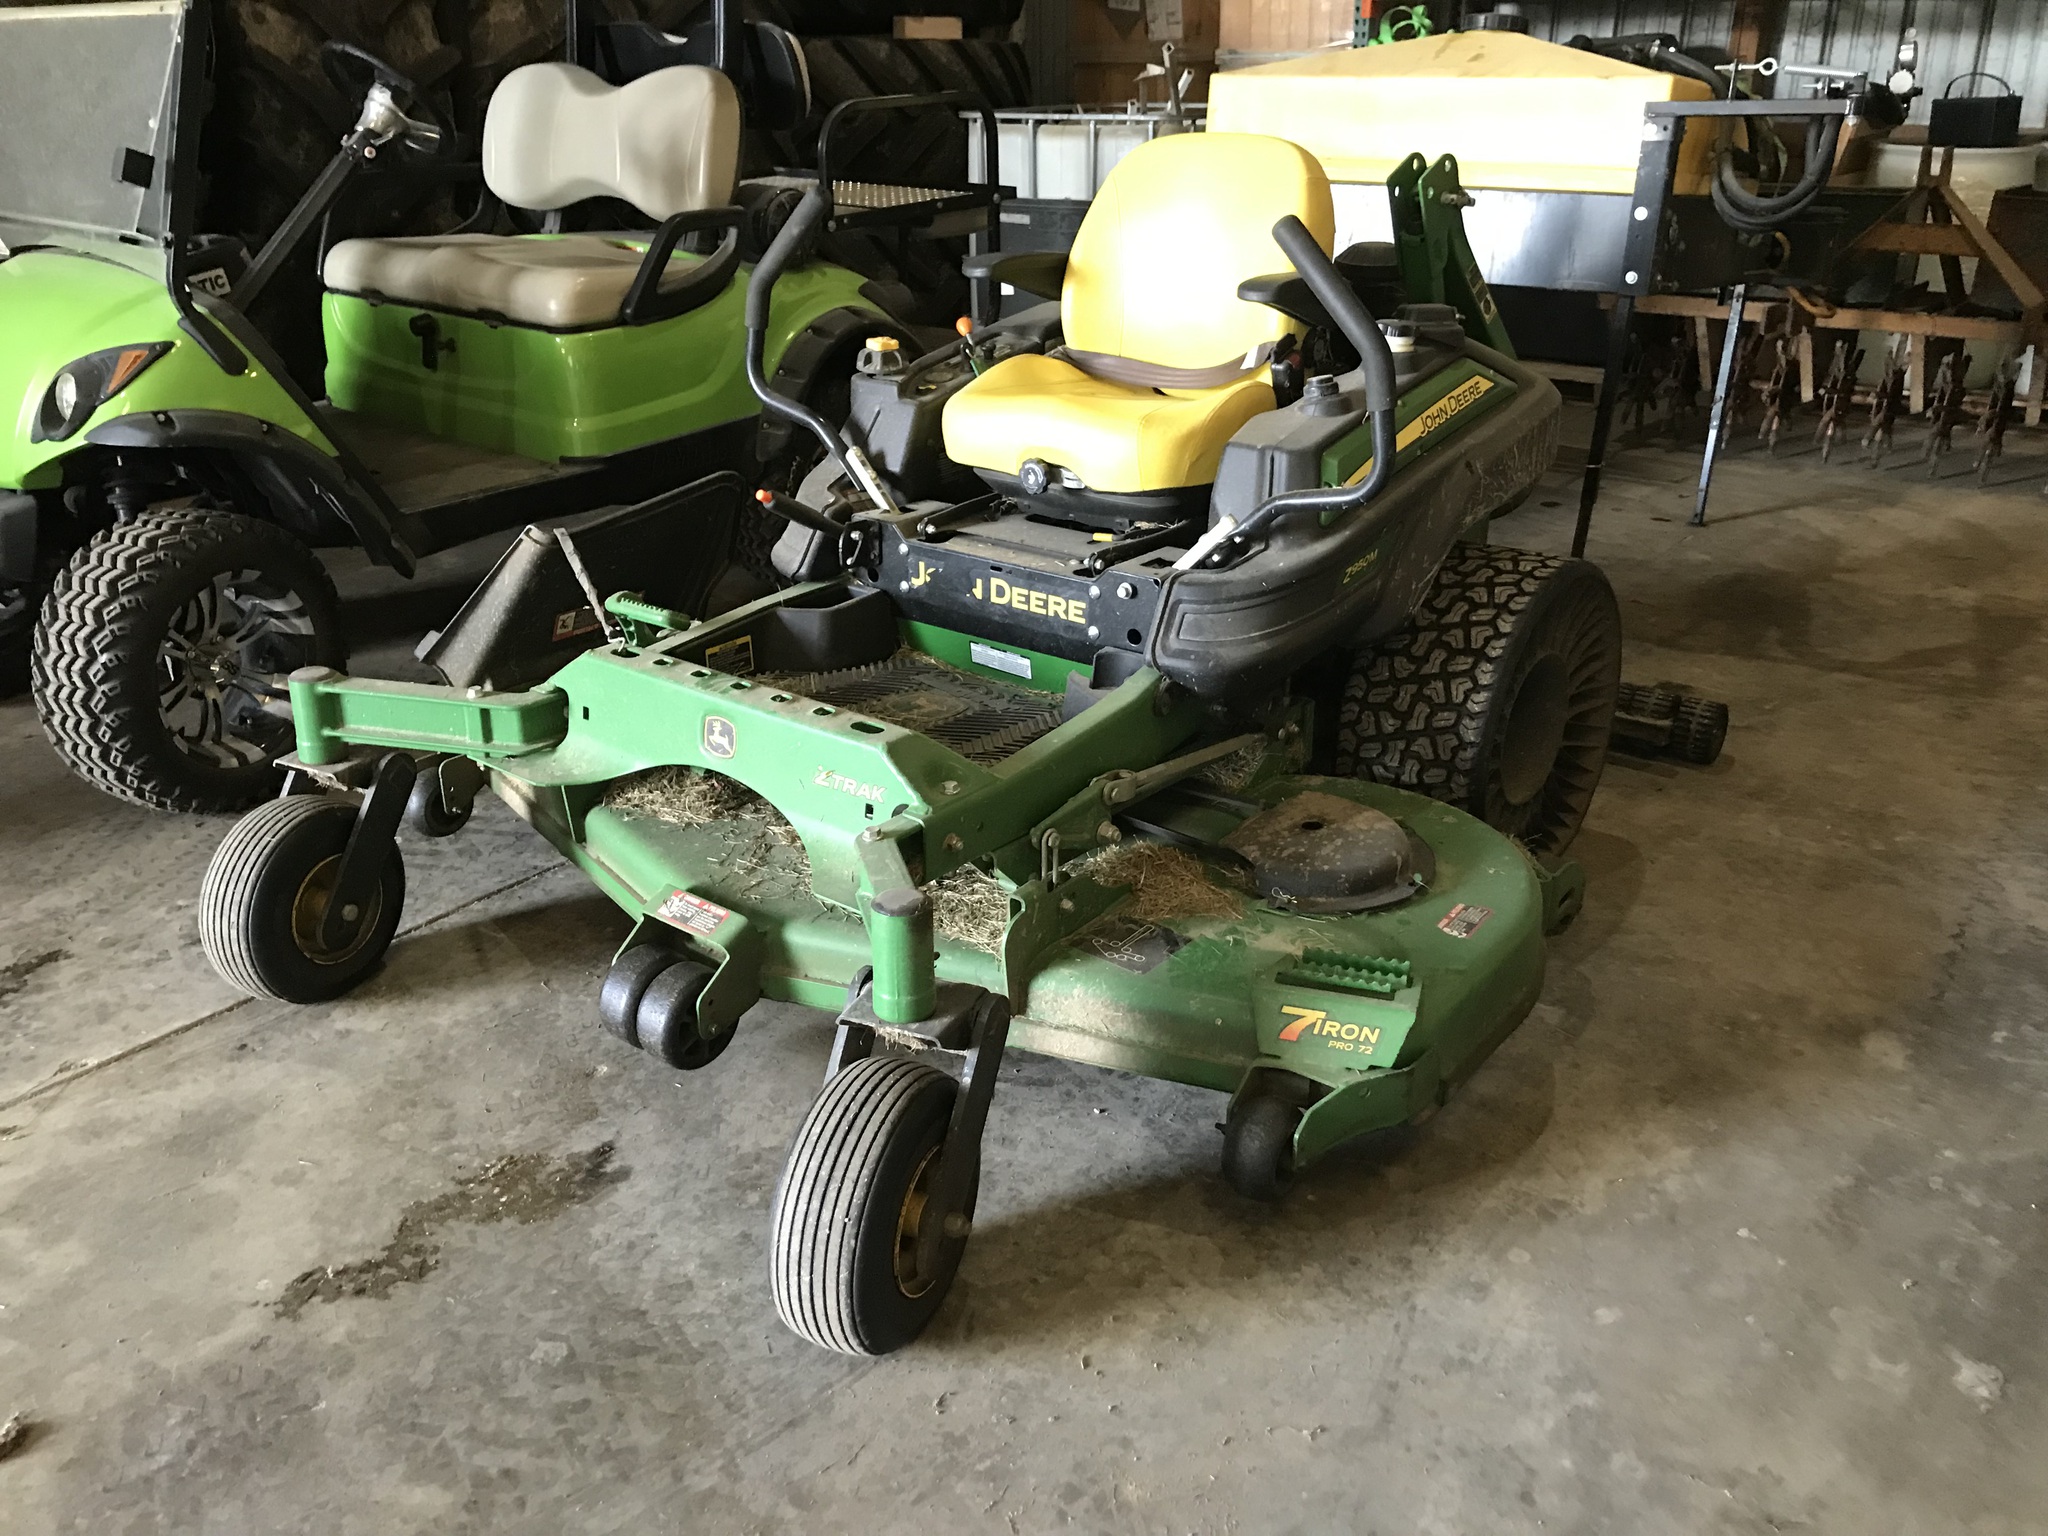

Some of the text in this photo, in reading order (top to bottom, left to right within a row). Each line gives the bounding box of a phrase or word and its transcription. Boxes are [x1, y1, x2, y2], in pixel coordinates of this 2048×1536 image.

[192, 274, 226, 292] TIC
[1420, 381, 1482, 435] JOHN DEERE
[989, 577, 1087, 625] DEERE
[1327, 1040, 1374, 1055] PRO 72
